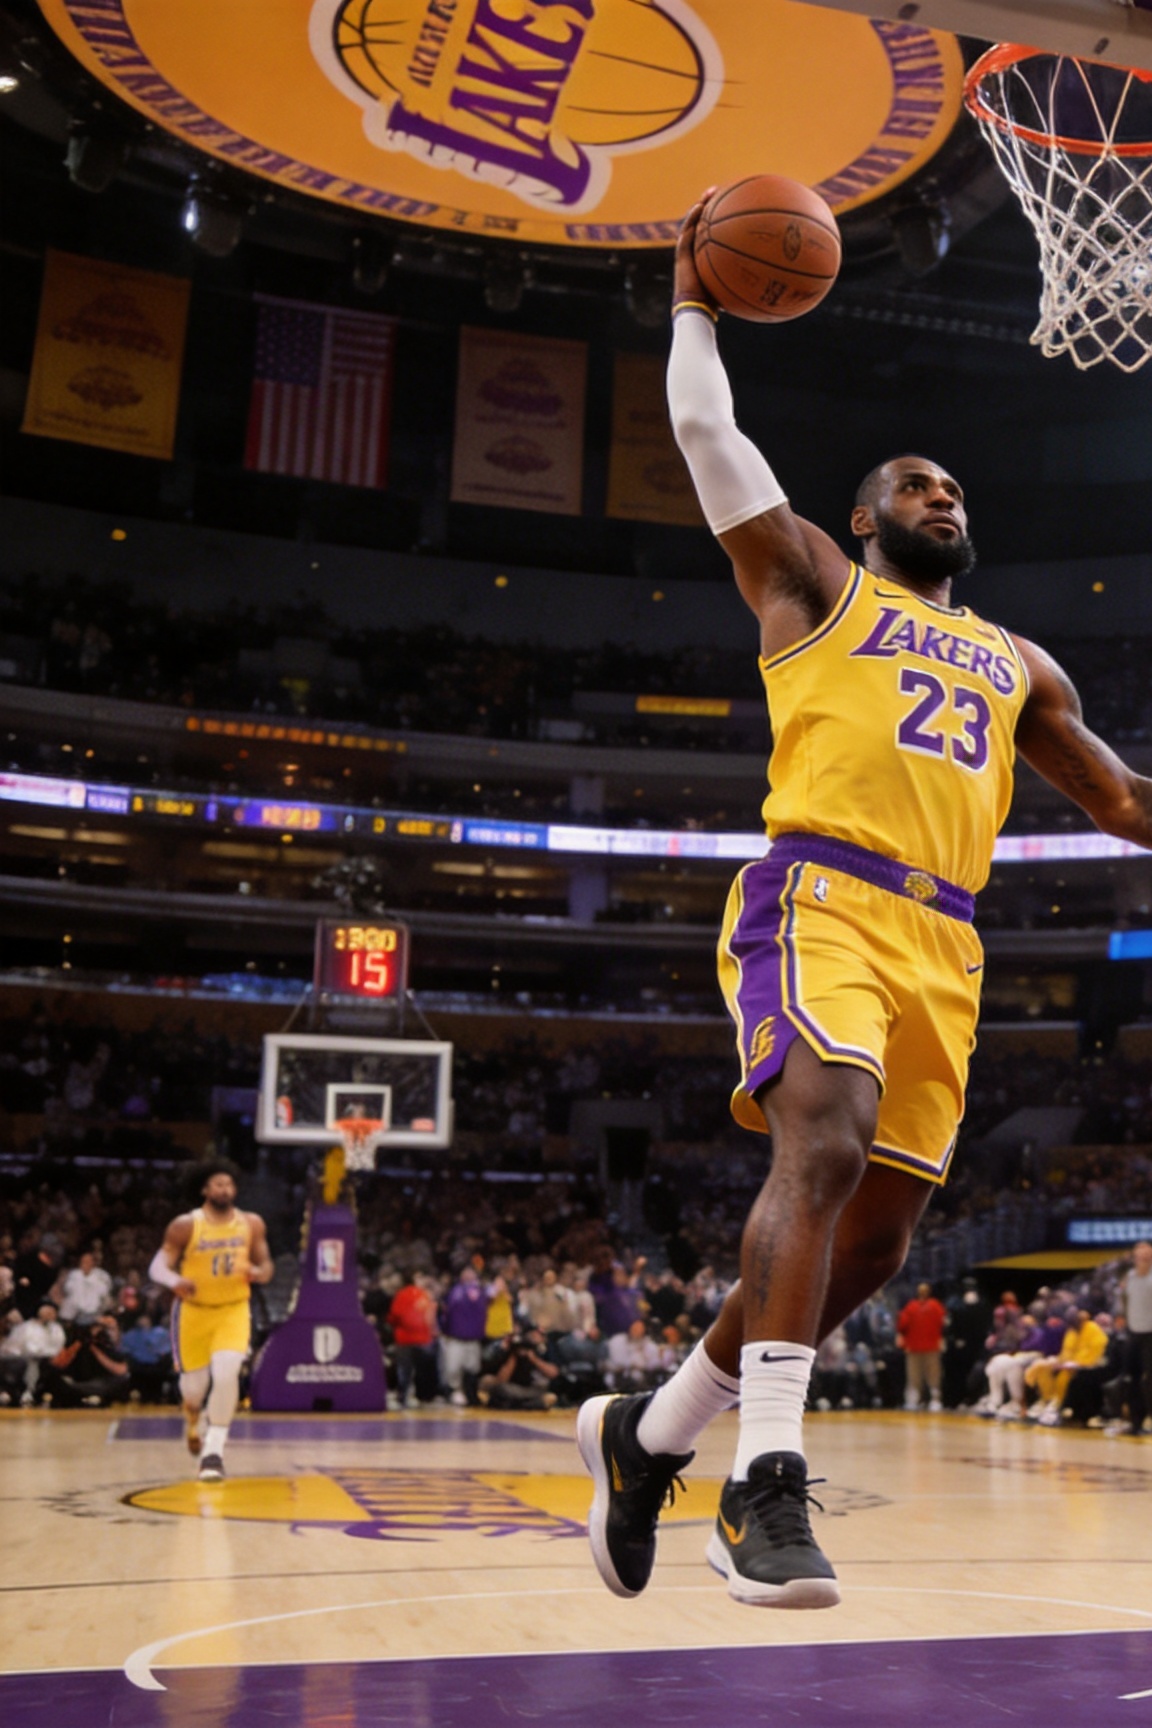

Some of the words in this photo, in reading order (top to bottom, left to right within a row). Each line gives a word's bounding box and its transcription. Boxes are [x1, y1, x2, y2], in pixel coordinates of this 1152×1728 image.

[849, 606, 1016, 697] LAKERS
[896, 667, 992, 773] 23
[350, 952, 388, 992] 15
